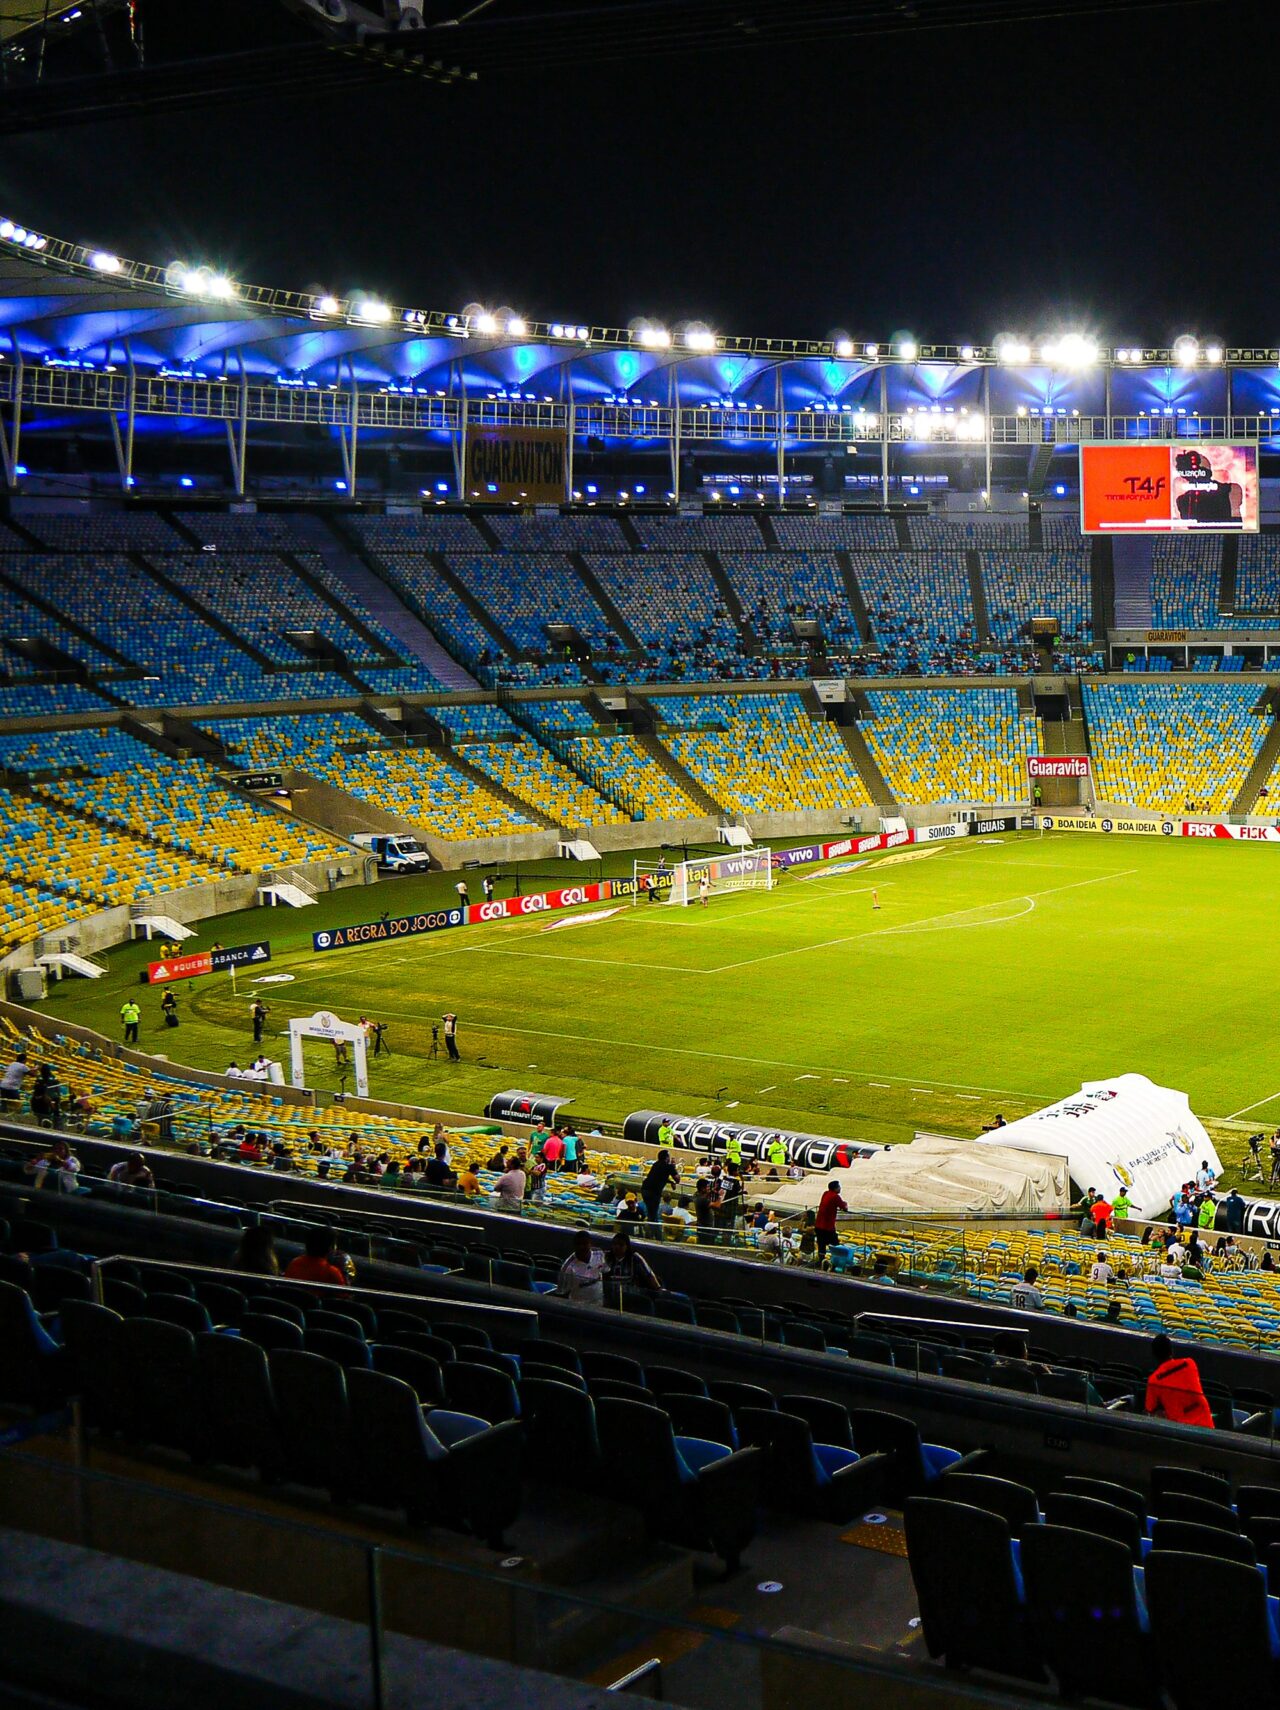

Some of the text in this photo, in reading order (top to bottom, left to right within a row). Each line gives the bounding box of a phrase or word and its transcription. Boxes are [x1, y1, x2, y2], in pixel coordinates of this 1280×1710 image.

[472, 439, 563, 483] GUARAVITON
[1148, 631, 1187, 641] GUARAVITON
[1029, 759, 1087, 775] Guaravita
[929, 820, 1005, 839] SOMOS IGUAIS
[1058, 820, 1075, 828] BOA
[1076, 820, 1097, 829] IDEIA
[1103, 821, 1111, 831] 51
[1117, 822, 1134, 831] BOA
[1136, 823, 1157, 832] IDEIA
[1163, 824, 1172, 833] 51
[1188, 824, 1216, 837] FISK
[1240, 827, 1268, 839] FISK
[480, 887, 589, 920] GOL GOL GOL
[334, 912, 447, 945] A REGRA DO JOGO
[174, 951, 249, 972] #QUEBREABANCA
[1015, 1294, 1025, 1308] 18
